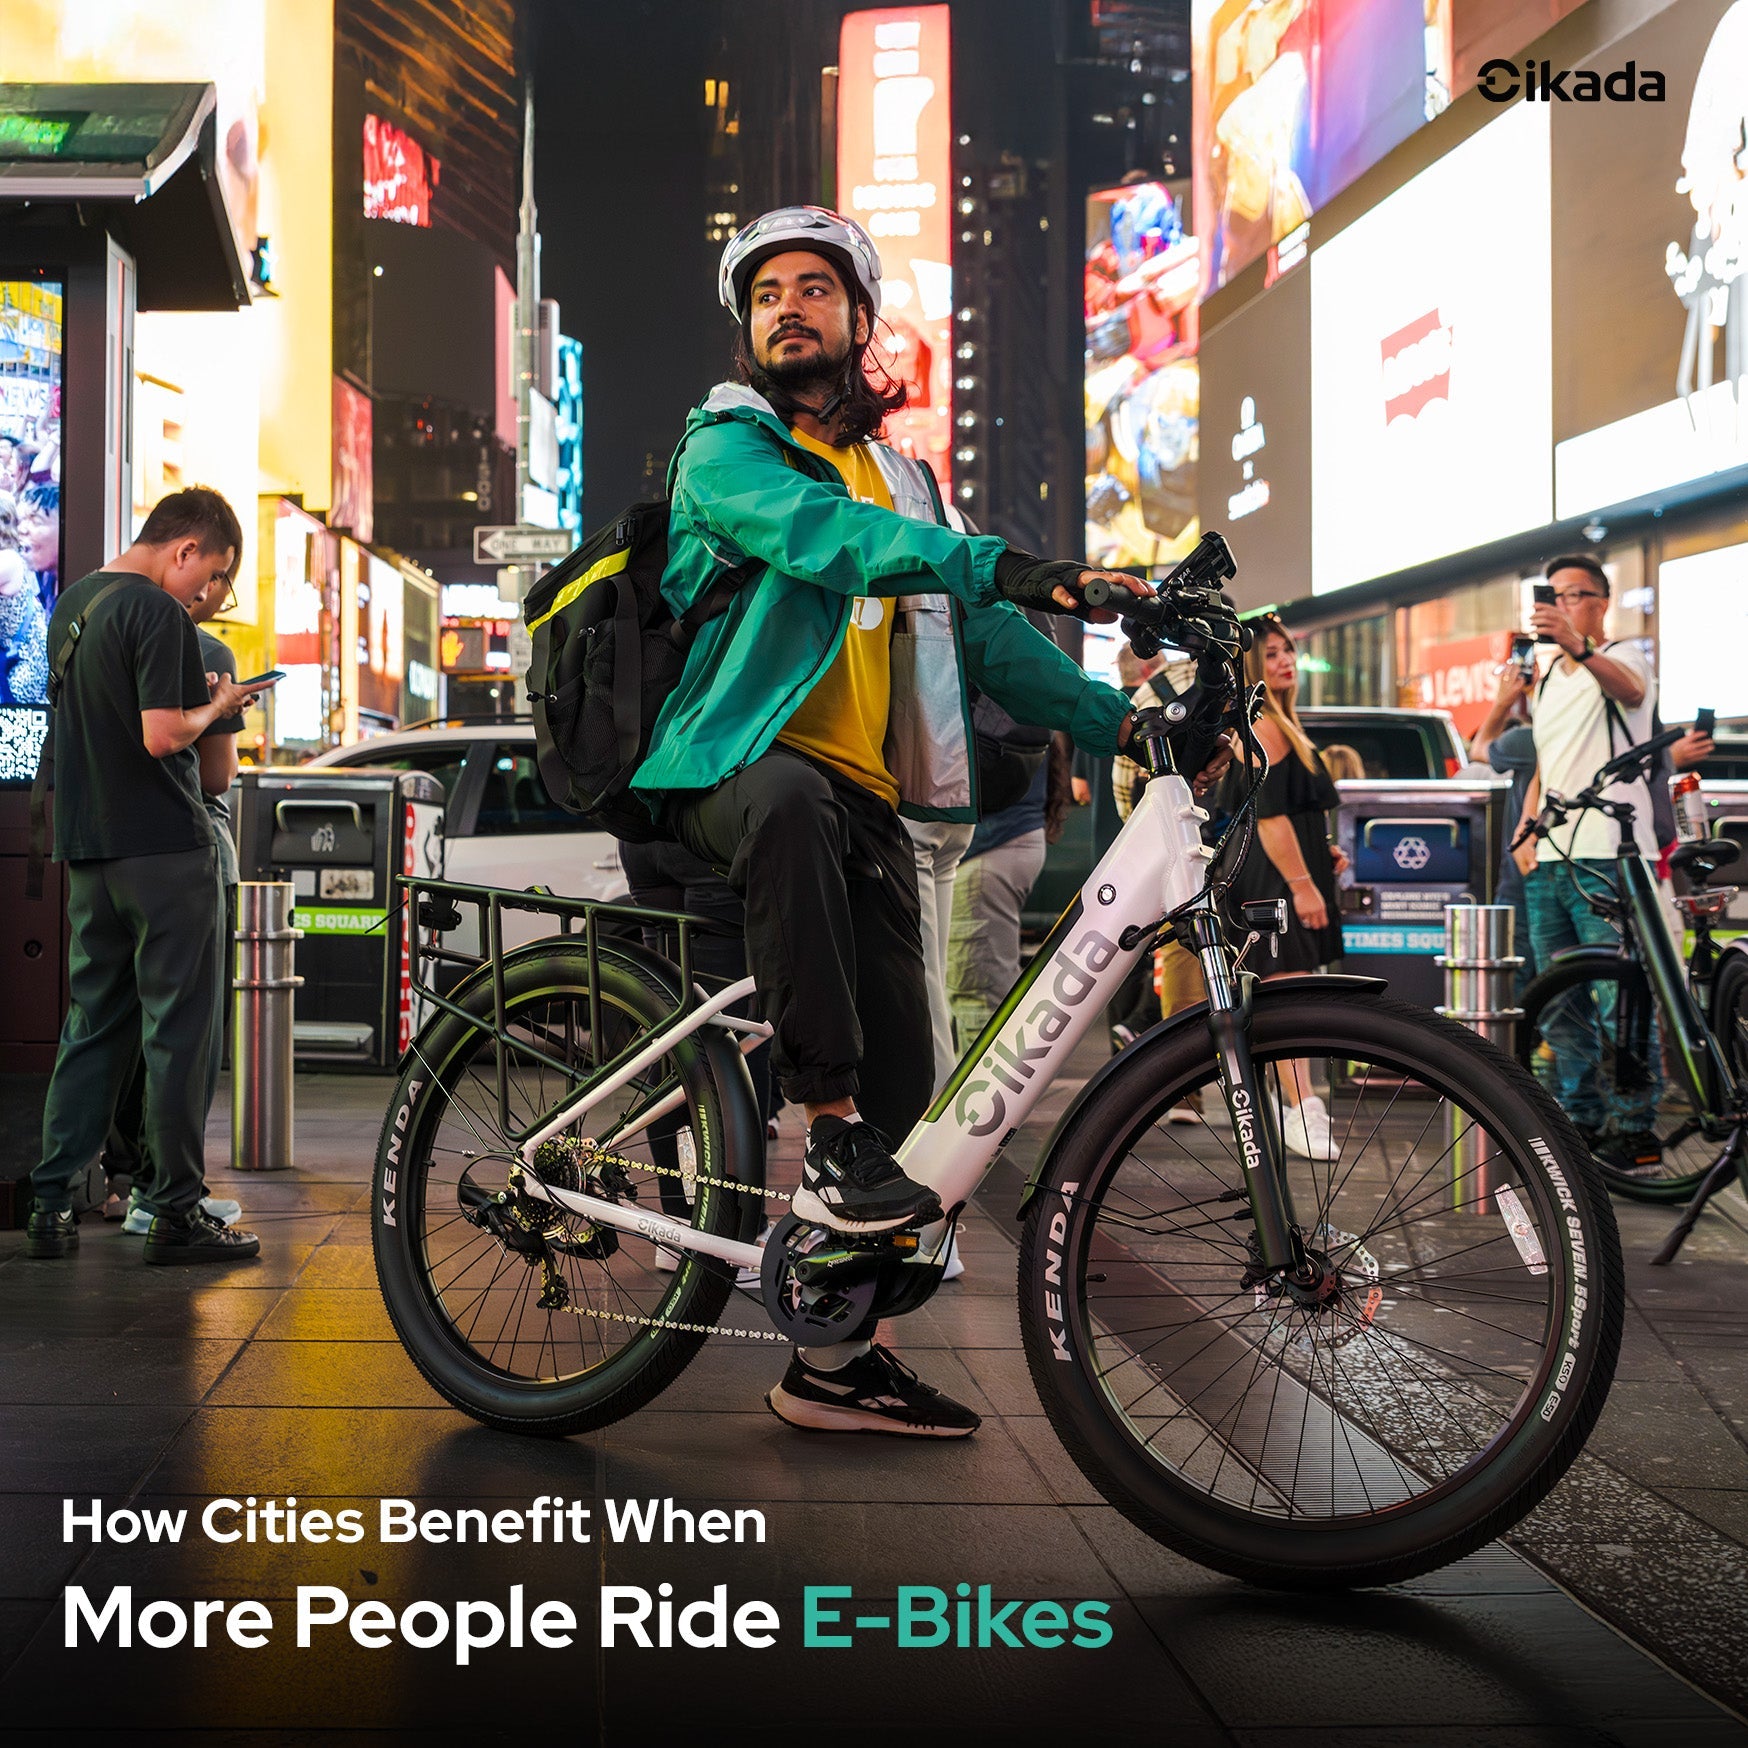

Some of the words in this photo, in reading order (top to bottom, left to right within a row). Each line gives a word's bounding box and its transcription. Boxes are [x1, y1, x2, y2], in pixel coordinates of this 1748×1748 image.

[1342, 932, 1404, 949] TIMES
[383, 1079, 424, 1228] KENDA
[1044, 1181, 1080, 1362] KENDA
